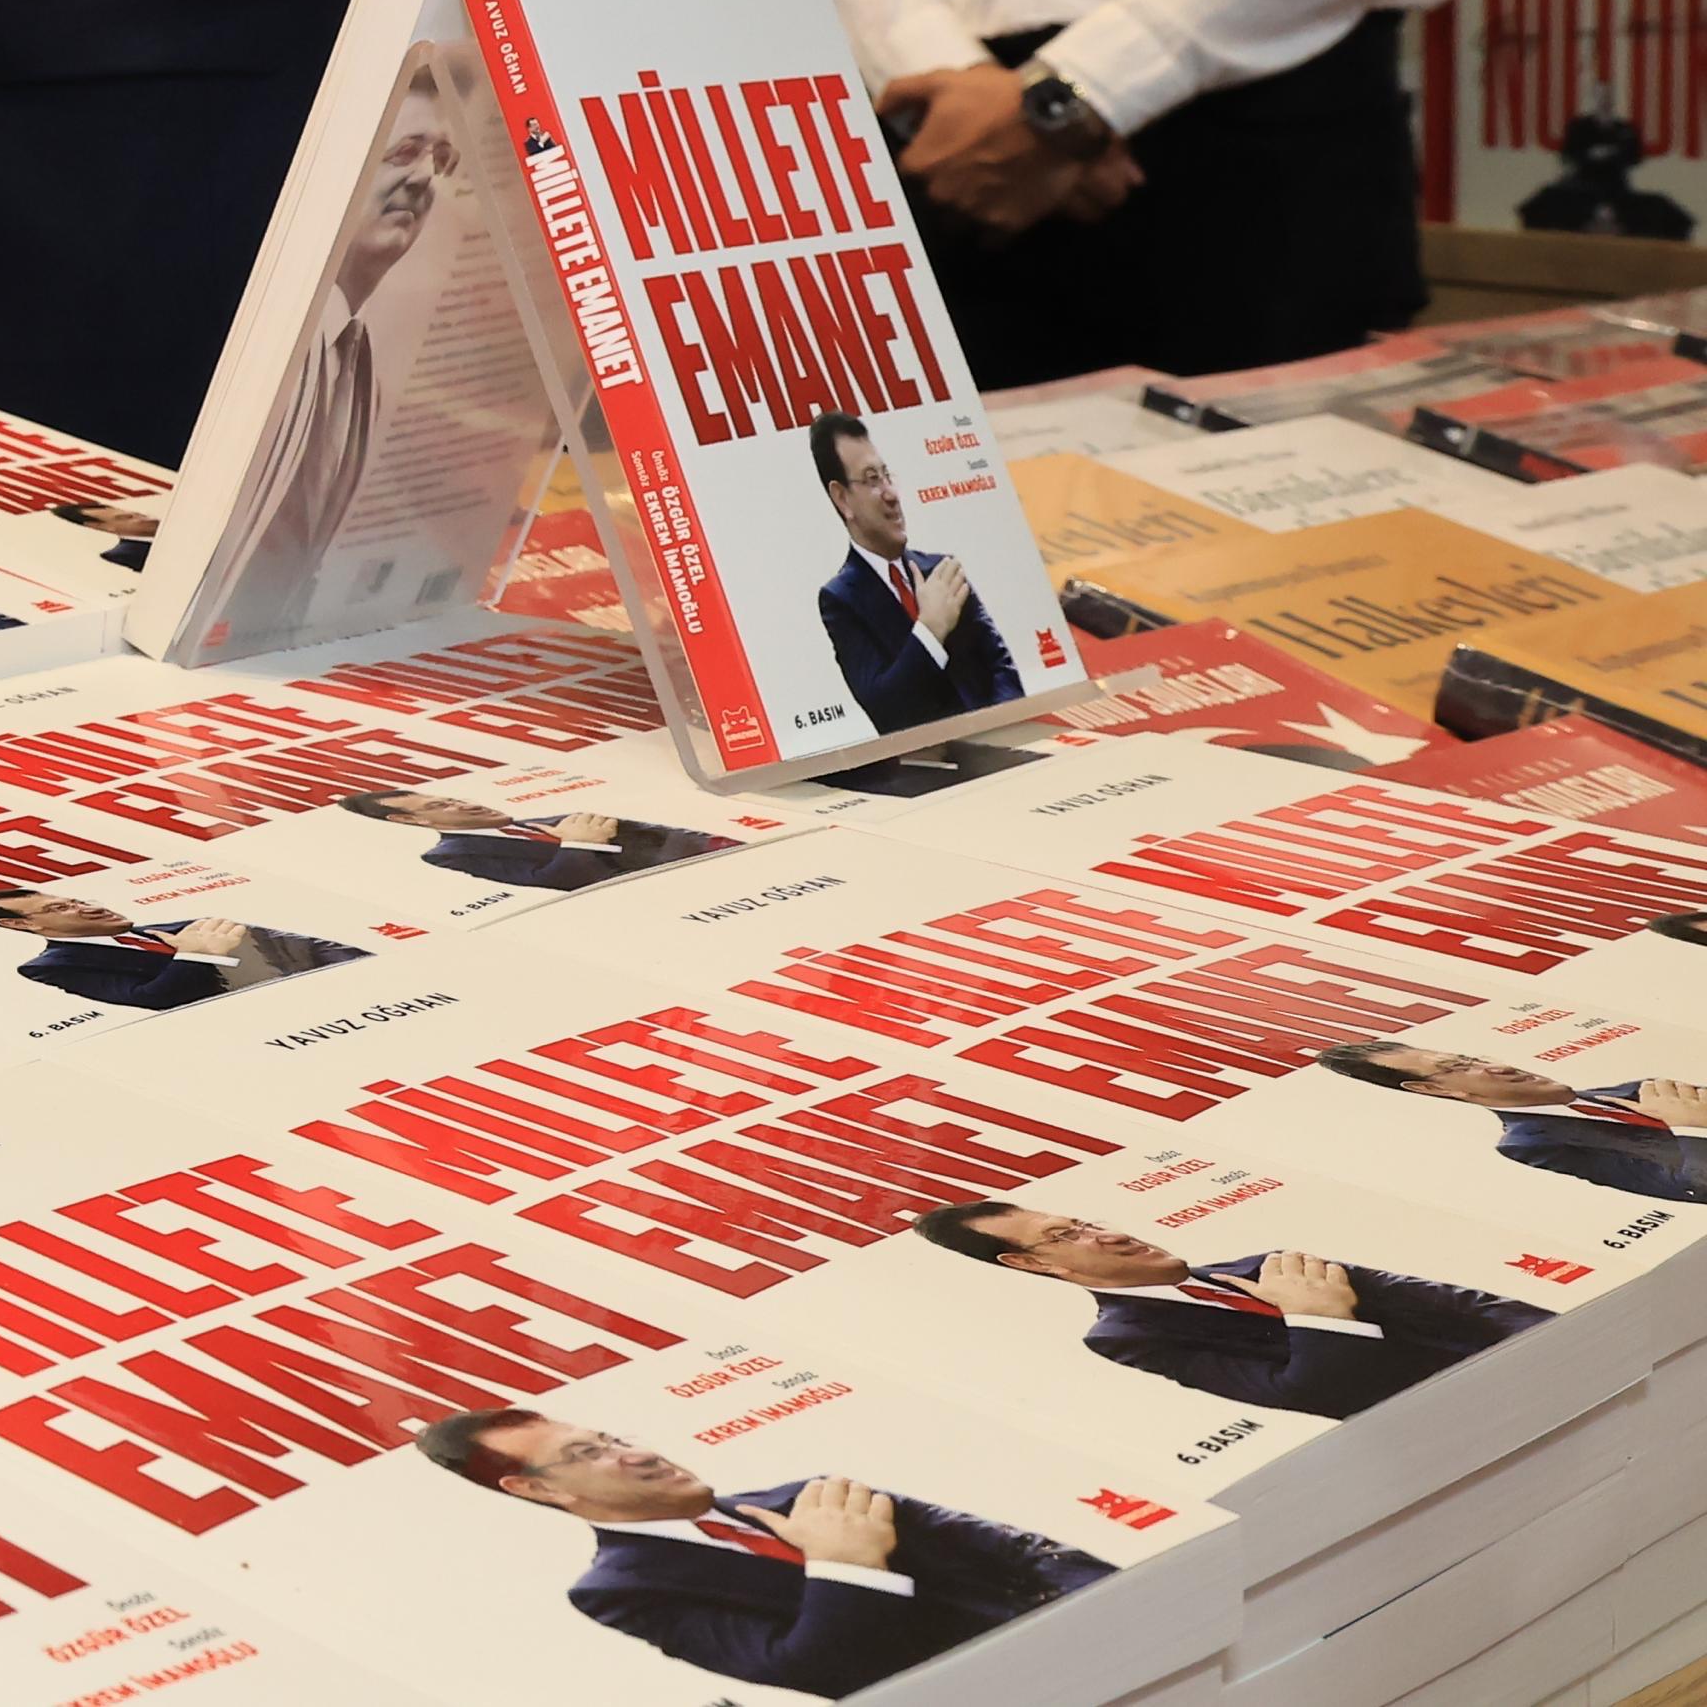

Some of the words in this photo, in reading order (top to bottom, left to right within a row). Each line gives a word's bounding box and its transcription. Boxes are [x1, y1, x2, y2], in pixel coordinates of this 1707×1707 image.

[500, 42, 527, 95] OĞHAN
[579, 70, 896, 262] MİLLETE
[525, 144, 601, 272] MİLLETE
[566, 263, 644, 390] EMANET
[642, 243, 953, 447] EMANET
[643, 490, 669, 549] EKREM
[662, 550, 705, 635] İMAMOĞLU
[661, 485, 692, 546] ÖZGÜR
[680, 541, 706, 586] ÖZEL
[1249, 562, 1605, 661] Halkevleri
[1, 685, 79, 708] OĞHAN
[794, 714, 808, 730] 6.
[809, 704, 847, 726] BASIM
[68, 730, 509, 841] EMANET
[1030, 791, 1102, 817] YAVUZ
[1103, 772, 1173, 797] OĞHAN
[1090, 784, 1556, 917] MİLLETE
[471, 889, 515, 913] BASIM
[681, 896, 768, 925] YAVUZ
[768, 875, 846, 905] OĞHAN
[729, 888, 1251, 1049] MİLLETE
[47, 1009, 105, 1035] BASIM
[265, 1021, 365, 1053] YAVUZ
[366, 991, 459, 1026] OĞHAN
[955, 944, 1490, 1122] EMANET
[289, 1005, 882, 1205] MİLLETE
[514, 1073, 1127, 1299] EMANET
[1116, 1166, 1171, 1195] ÖZGÜR
[1170, 1157, 1216, 1177] ÖZEL
[1155, 1199, 1211, 1230] EKREM
[1209, 1177, 1285, 1212] İMAMOĞLU
[1602, 1234, 1625, 1251] 6.
[1625, 1209, 1676, 1243] BASIM
[663, 1364, 724, 1400] ÖZGÜR
[725, 1352, 784, 1379] ÖZEL
[693, 1404, 762, 1447] EKREM
[758, 1380, 853, 1425] İMAMOĞLU
[1176, 1448, 1201, 1466] 6.
[1202, 1418, 1265, 1456] BASIM
[43, 1628, 127, 1665] ÖZGÜR
[127, 1605, 190, 1639] ÖZEL
[131, 1638, 259, 1694] İMAMOĞLU
